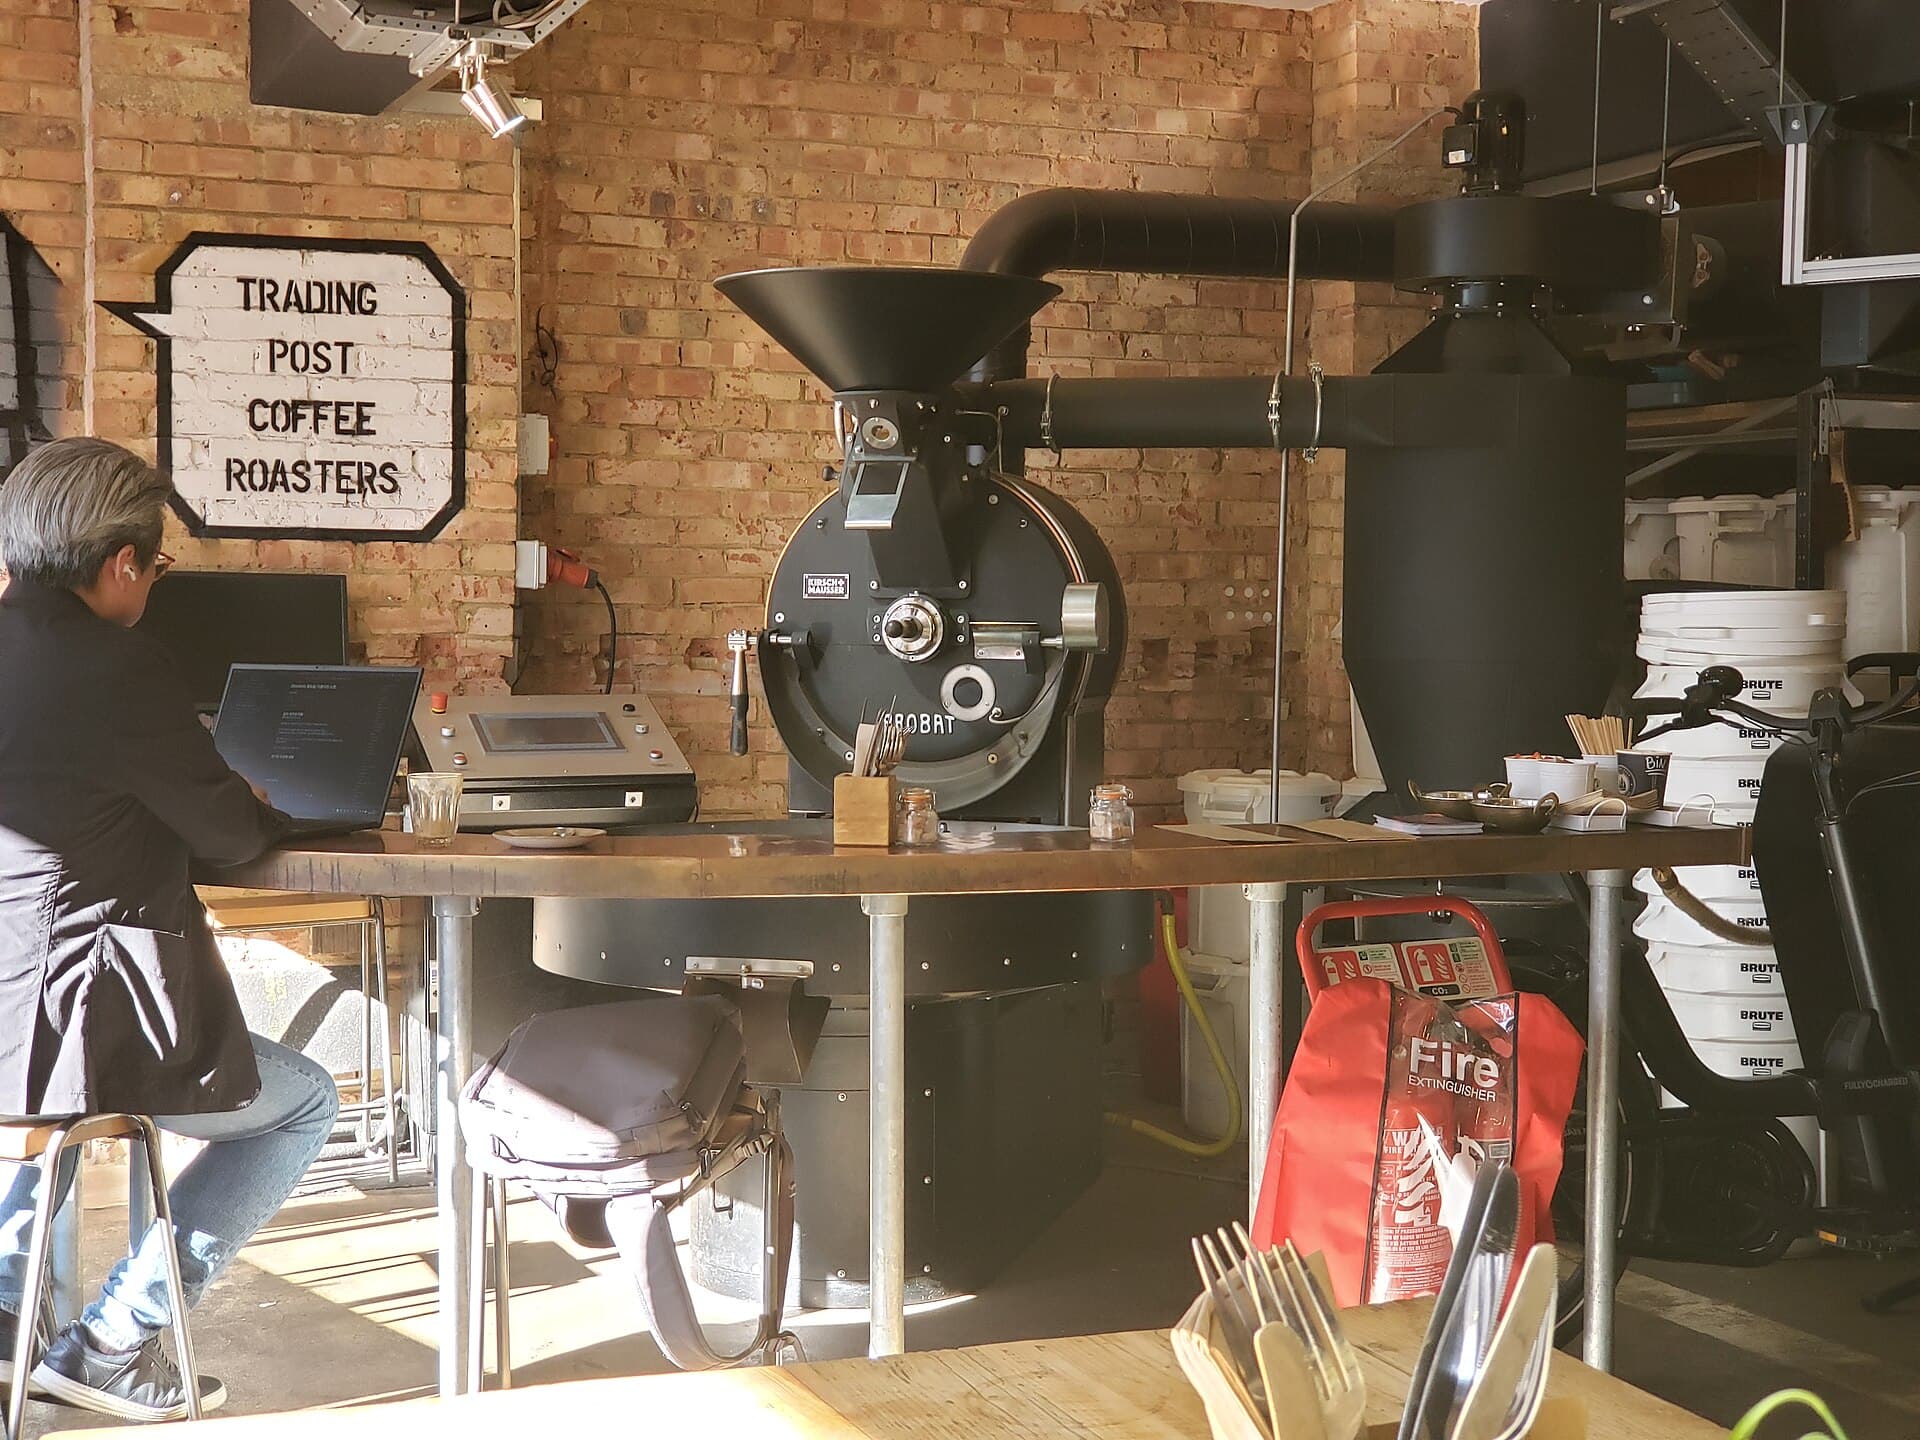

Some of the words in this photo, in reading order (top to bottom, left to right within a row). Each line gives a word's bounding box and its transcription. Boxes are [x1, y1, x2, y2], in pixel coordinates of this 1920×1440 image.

[237, 278, 377, 315] TRADING
[269, 339, 354, 374] POST
[249, 398, 376, 436] COFFEE
[225, 457, 399, 494] ROASTERS
[1742, 680, 1783, 689] BRUTE
[1740, 1010, 1784, 1020] BRUTE
[1410, 1036, 1499, 1088] Fire
[1740, 1057, 1784, 1067] BRUTE
[1408, 1074, 1497, 1102] EXTINGUISHER
